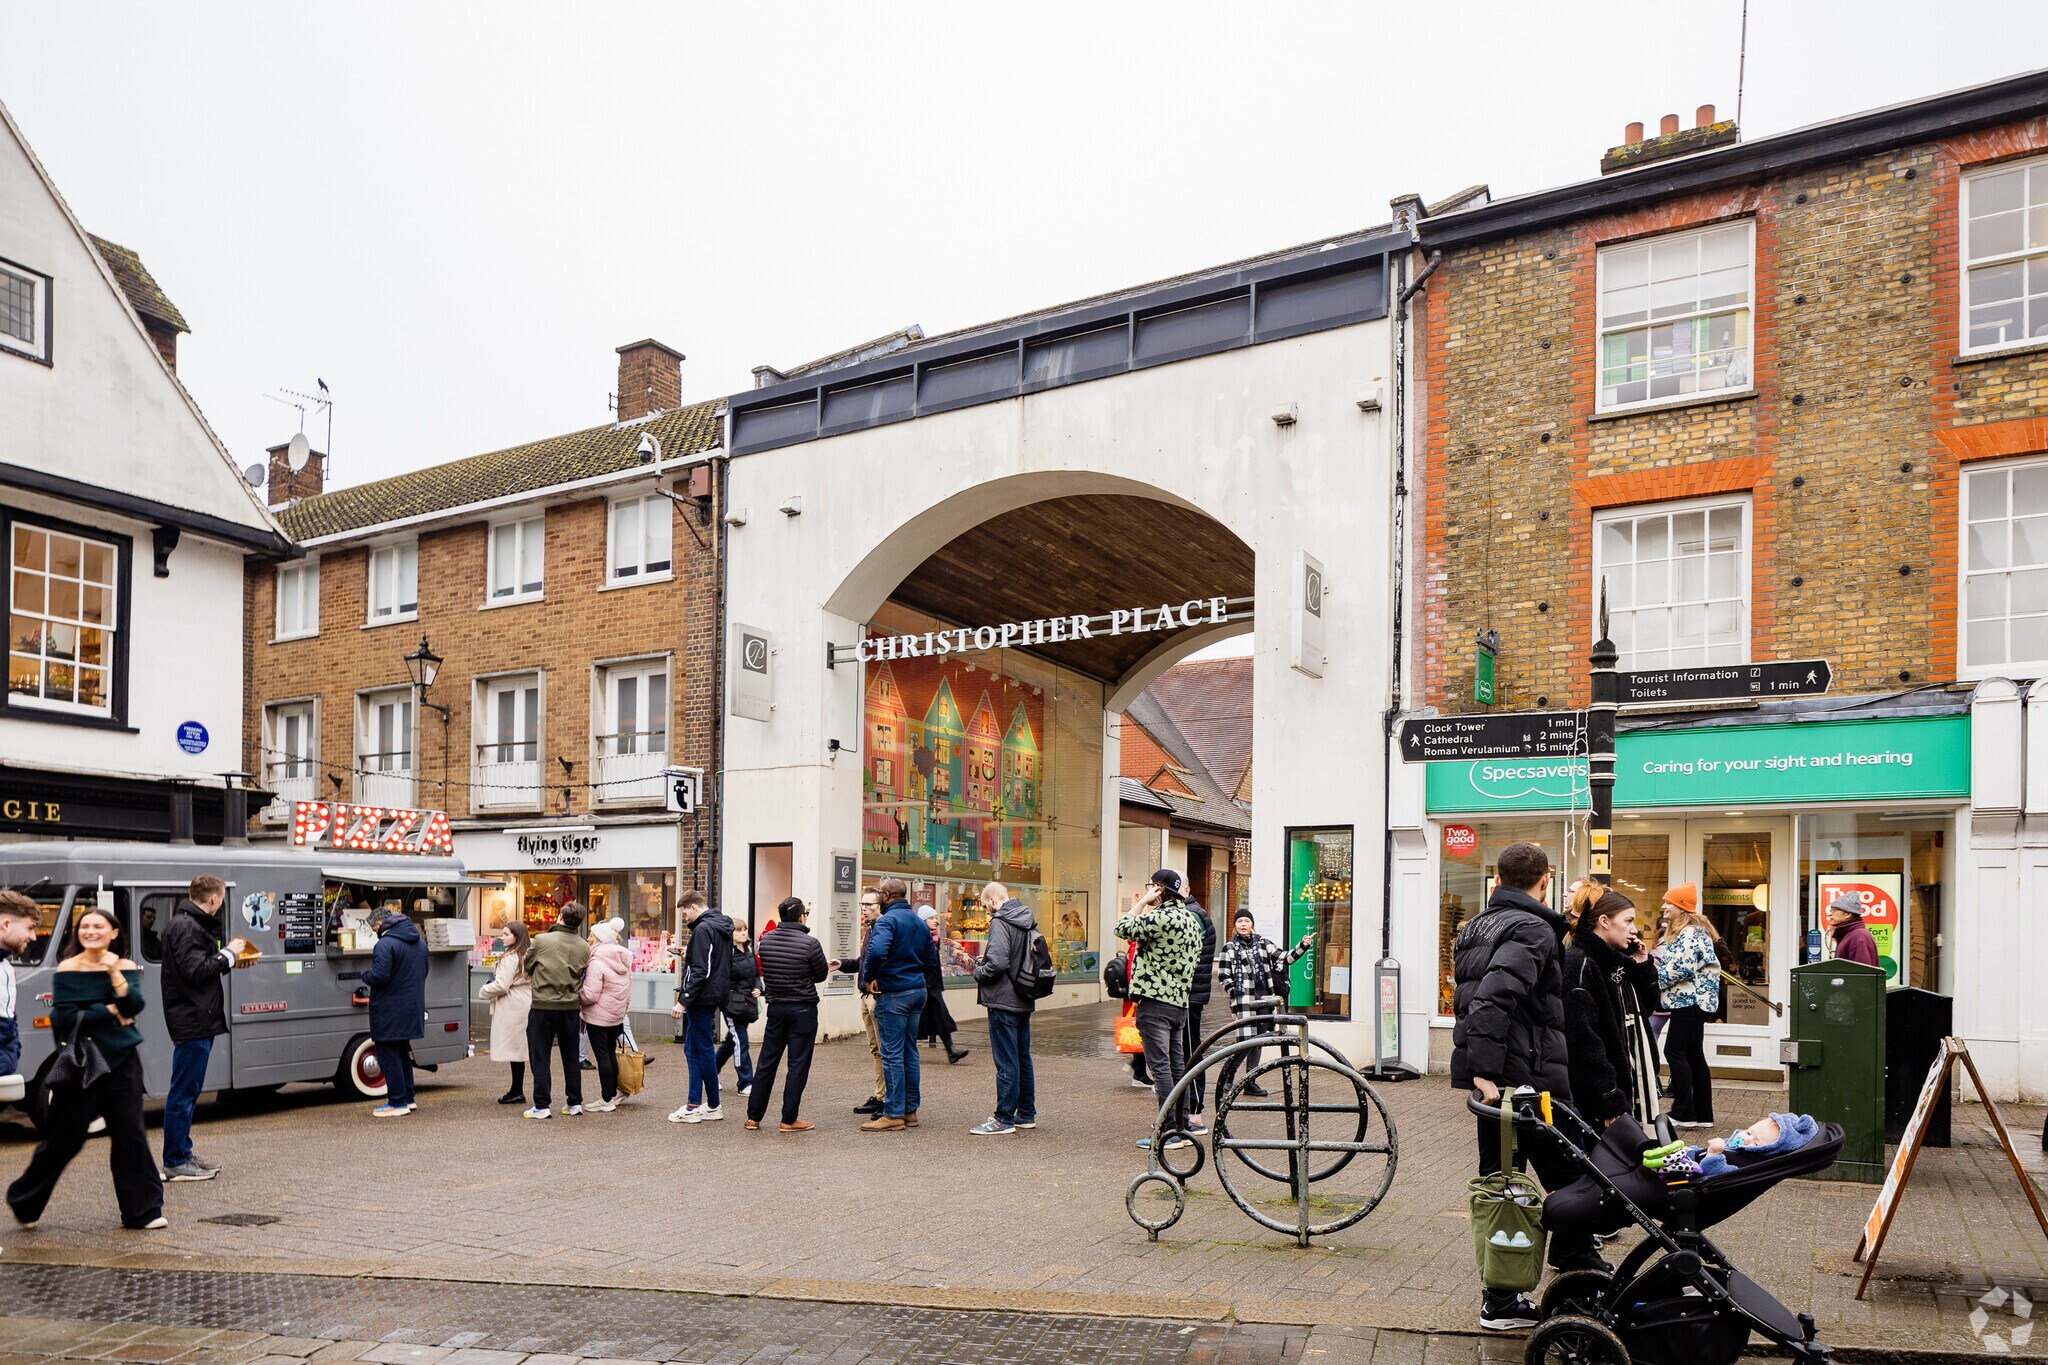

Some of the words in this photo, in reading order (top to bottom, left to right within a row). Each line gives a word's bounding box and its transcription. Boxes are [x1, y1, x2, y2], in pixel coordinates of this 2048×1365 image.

[855, 614, 1092, 663] CHRISTOPHER
[1109, 596, 1228, 636] PLACE
[1630, 673, 1669, 684] Tourist
[1672, 669, 1739, 683] Information
[1630, 687, 1667, 698] Toilets
[1769, 681, 1775, 690] 1
[1778, 679, 1800, 690] min
[1423, 724, 1453, 733] Clock
[1455, 723, 1486, 732] Tower
[1547, 719, 1552, 728] 1
[1555, 718, 1574, 727] min
[1423, 735, 1474, 745] Cathedral
[1540, 731, 1547, 740] 2
[1549, 730, 1574, 740] mins
[1423, 747, 1458, 756] Roman
[1460, 744, 1520, 755] Verulamium
[1535, 743, 1547, 752] 15
[1549, 742, 1574, 752] mins
[1642, 760, 1694, 775] Caring
[1696, 758, 1721, 772] for
[1723, 759, 1762, 774] your
[1764, 755, 1807, 771] sight
[1809, 753, 1842, 767] and
[1846, 750, 1913, 767] hearing
[1482, 764, 1588, 783] Specsavers
[292, 801, 455, 854] PIZZA
[1446, 828, 1469, 837] Two
[517, 834, 560, 856] flying
[561, 834, 600, 854] tiger
[1446, 834, 1475, 846] good
